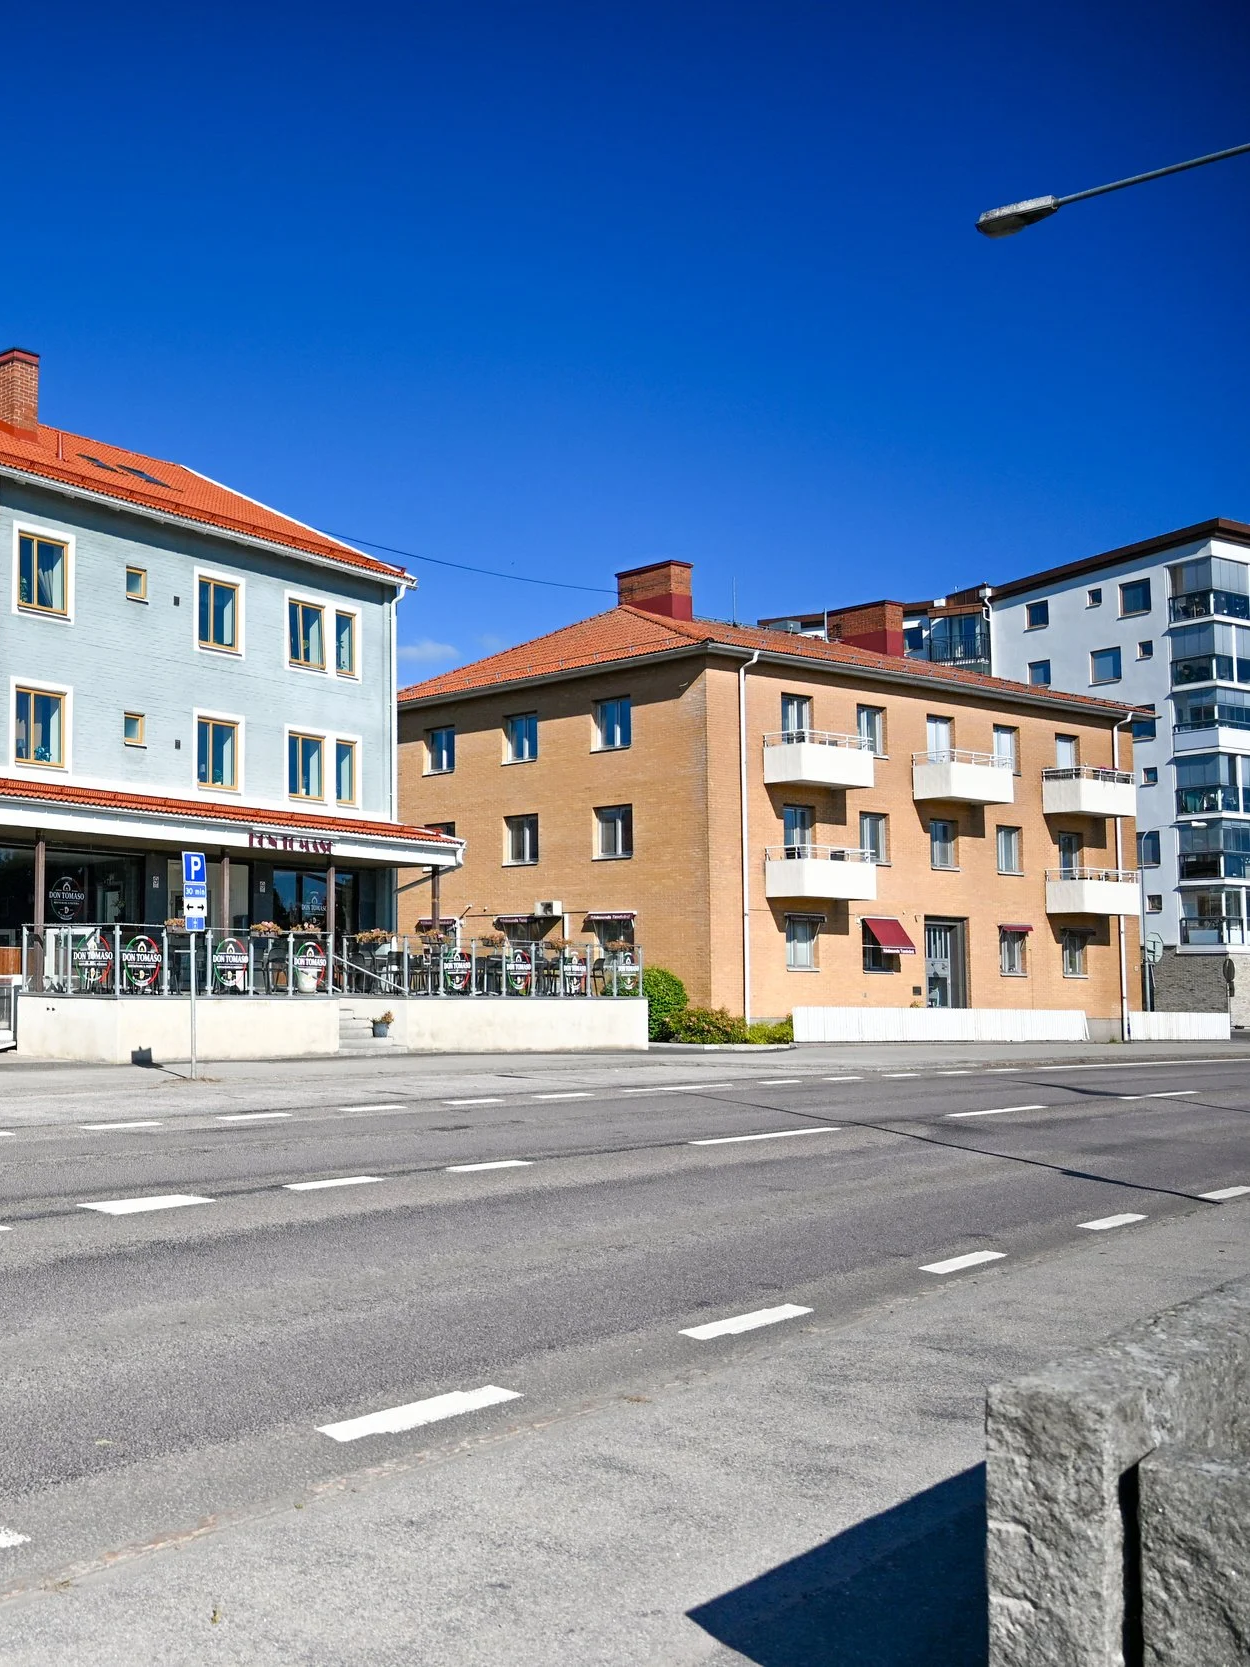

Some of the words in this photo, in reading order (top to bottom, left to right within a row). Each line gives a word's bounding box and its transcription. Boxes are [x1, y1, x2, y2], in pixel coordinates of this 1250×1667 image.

[191, 856, 201, 880] P
[49, 891, 61, 899] DON
[62, 892, 85, 900] TOMASO
[185, 887, 193, 895] 30
[195, 888, 205, 896] min
[73, 951, 86, 960] DON
[87, 951, 113, 960] TOMASO
[122, 952, 136, 962] DON
[136, 953, 162, 962] TOMASO
[212, 954, 224, 963] DON
[225, 955, 249, 964] TOMASO
[293, 957, 305, 966] DON
[306, 958, 327, 967] TOMASO
